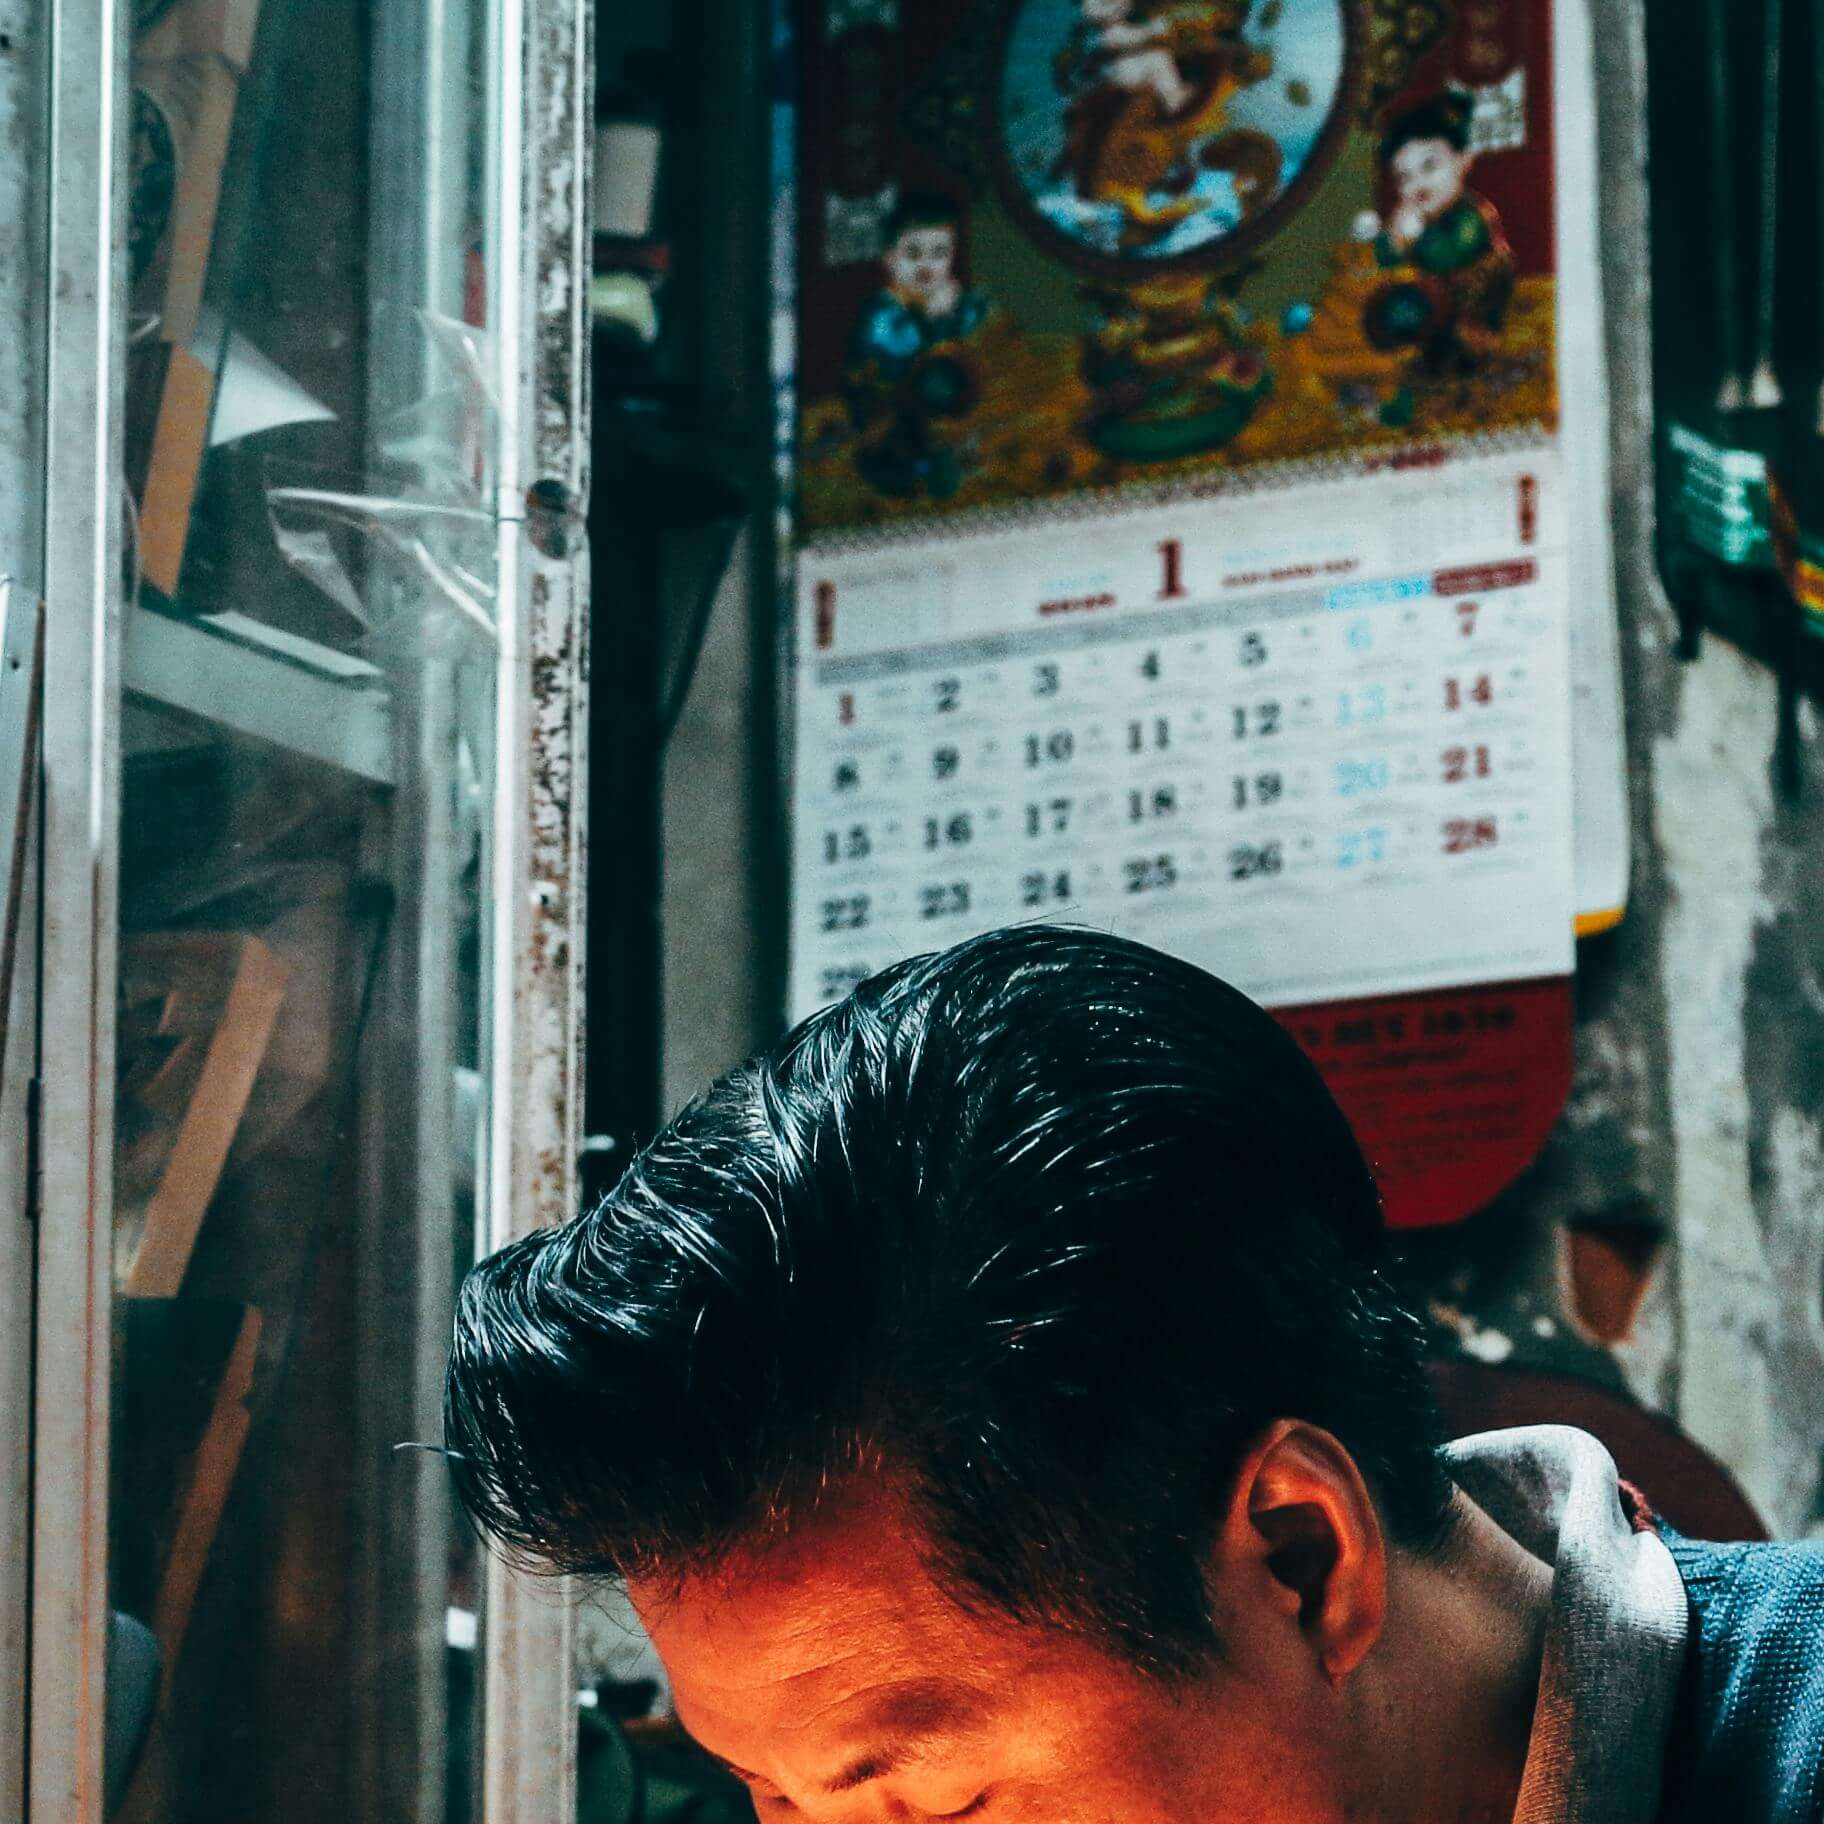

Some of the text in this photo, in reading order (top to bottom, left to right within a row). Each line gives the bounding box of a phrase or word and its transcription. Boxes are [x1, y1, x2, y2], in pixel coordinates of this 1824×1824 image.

[1156, 537, 1186, 598] 1
[838, 692, 856, 726] 1
[935, 677, 962, 712] 2
[1035, 662, 1059, 696] 3
[1140, 650, 1162, 681] 4
[1238, 630, 1268, 668] 5
[1456, 601, 1479, 637] 7
[933, 745, 961, 780] 9
[1025, 728, 1074, 768] 10
[1127, 717, 1170, 754] 11
[1233, 701, 1280, 740] 12
[1444, 673, 1493, 711] 14
[822, 824, 871, 864] 15
[923, 812, 972, 851] 16
[1026, 797, 1070, 837] 17
[1128, 784, 1175, 823] 18
[1233, 771, 1283, 810] 19
[1441, 744, 1490, 783] 21
[821, 815, 1497, 932] 22 23 24 25 26 27 28
